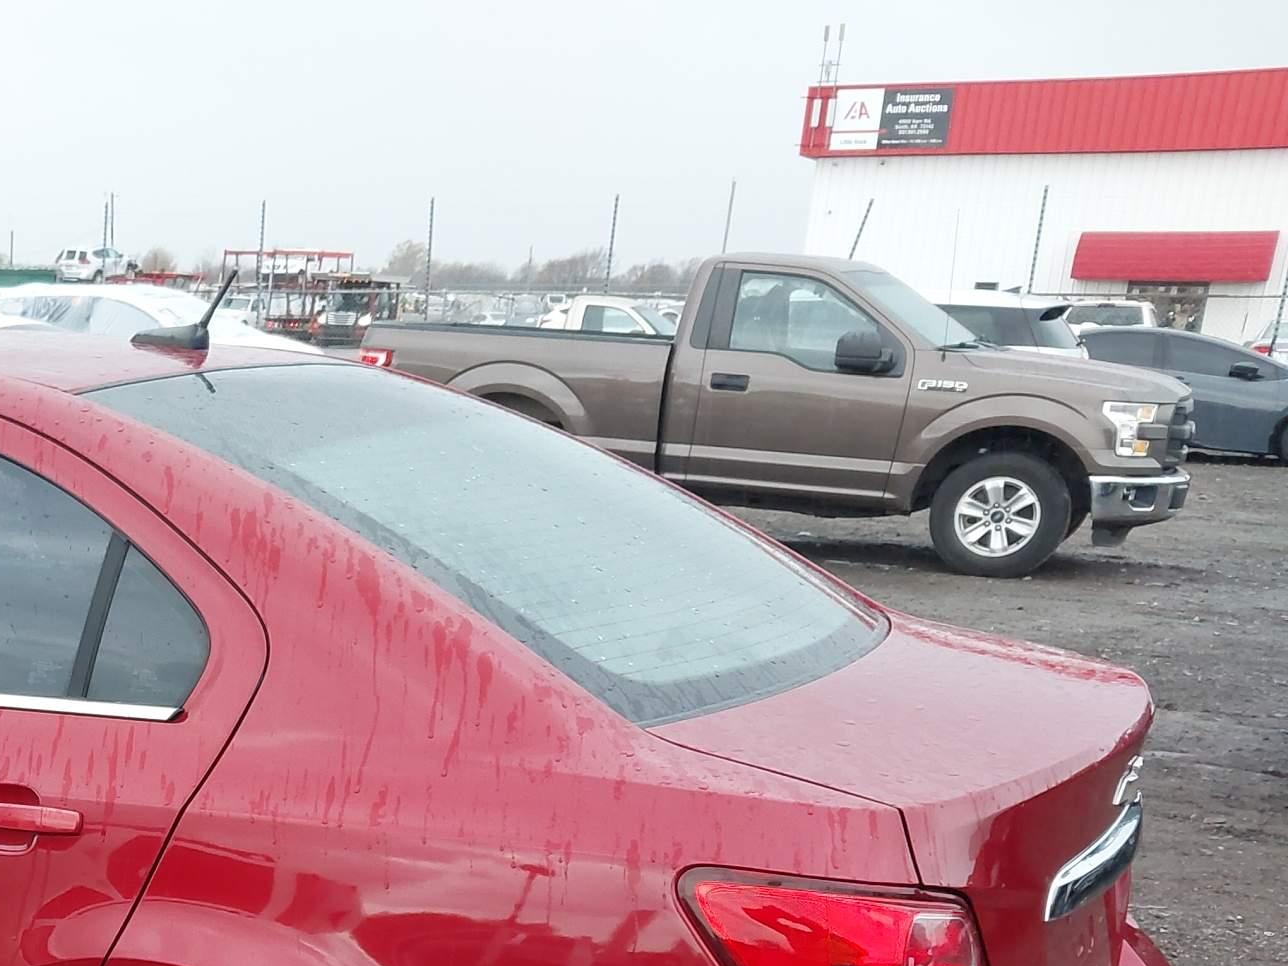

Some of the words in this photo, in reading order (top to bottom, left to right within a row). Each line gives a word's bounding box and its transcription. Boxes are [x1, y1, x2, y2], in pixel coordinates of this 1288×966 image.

[896, 92, 941, 103] Insurance
[885, 103, 907, 114] Auto
[908, 102, 949, 113] Auctions
